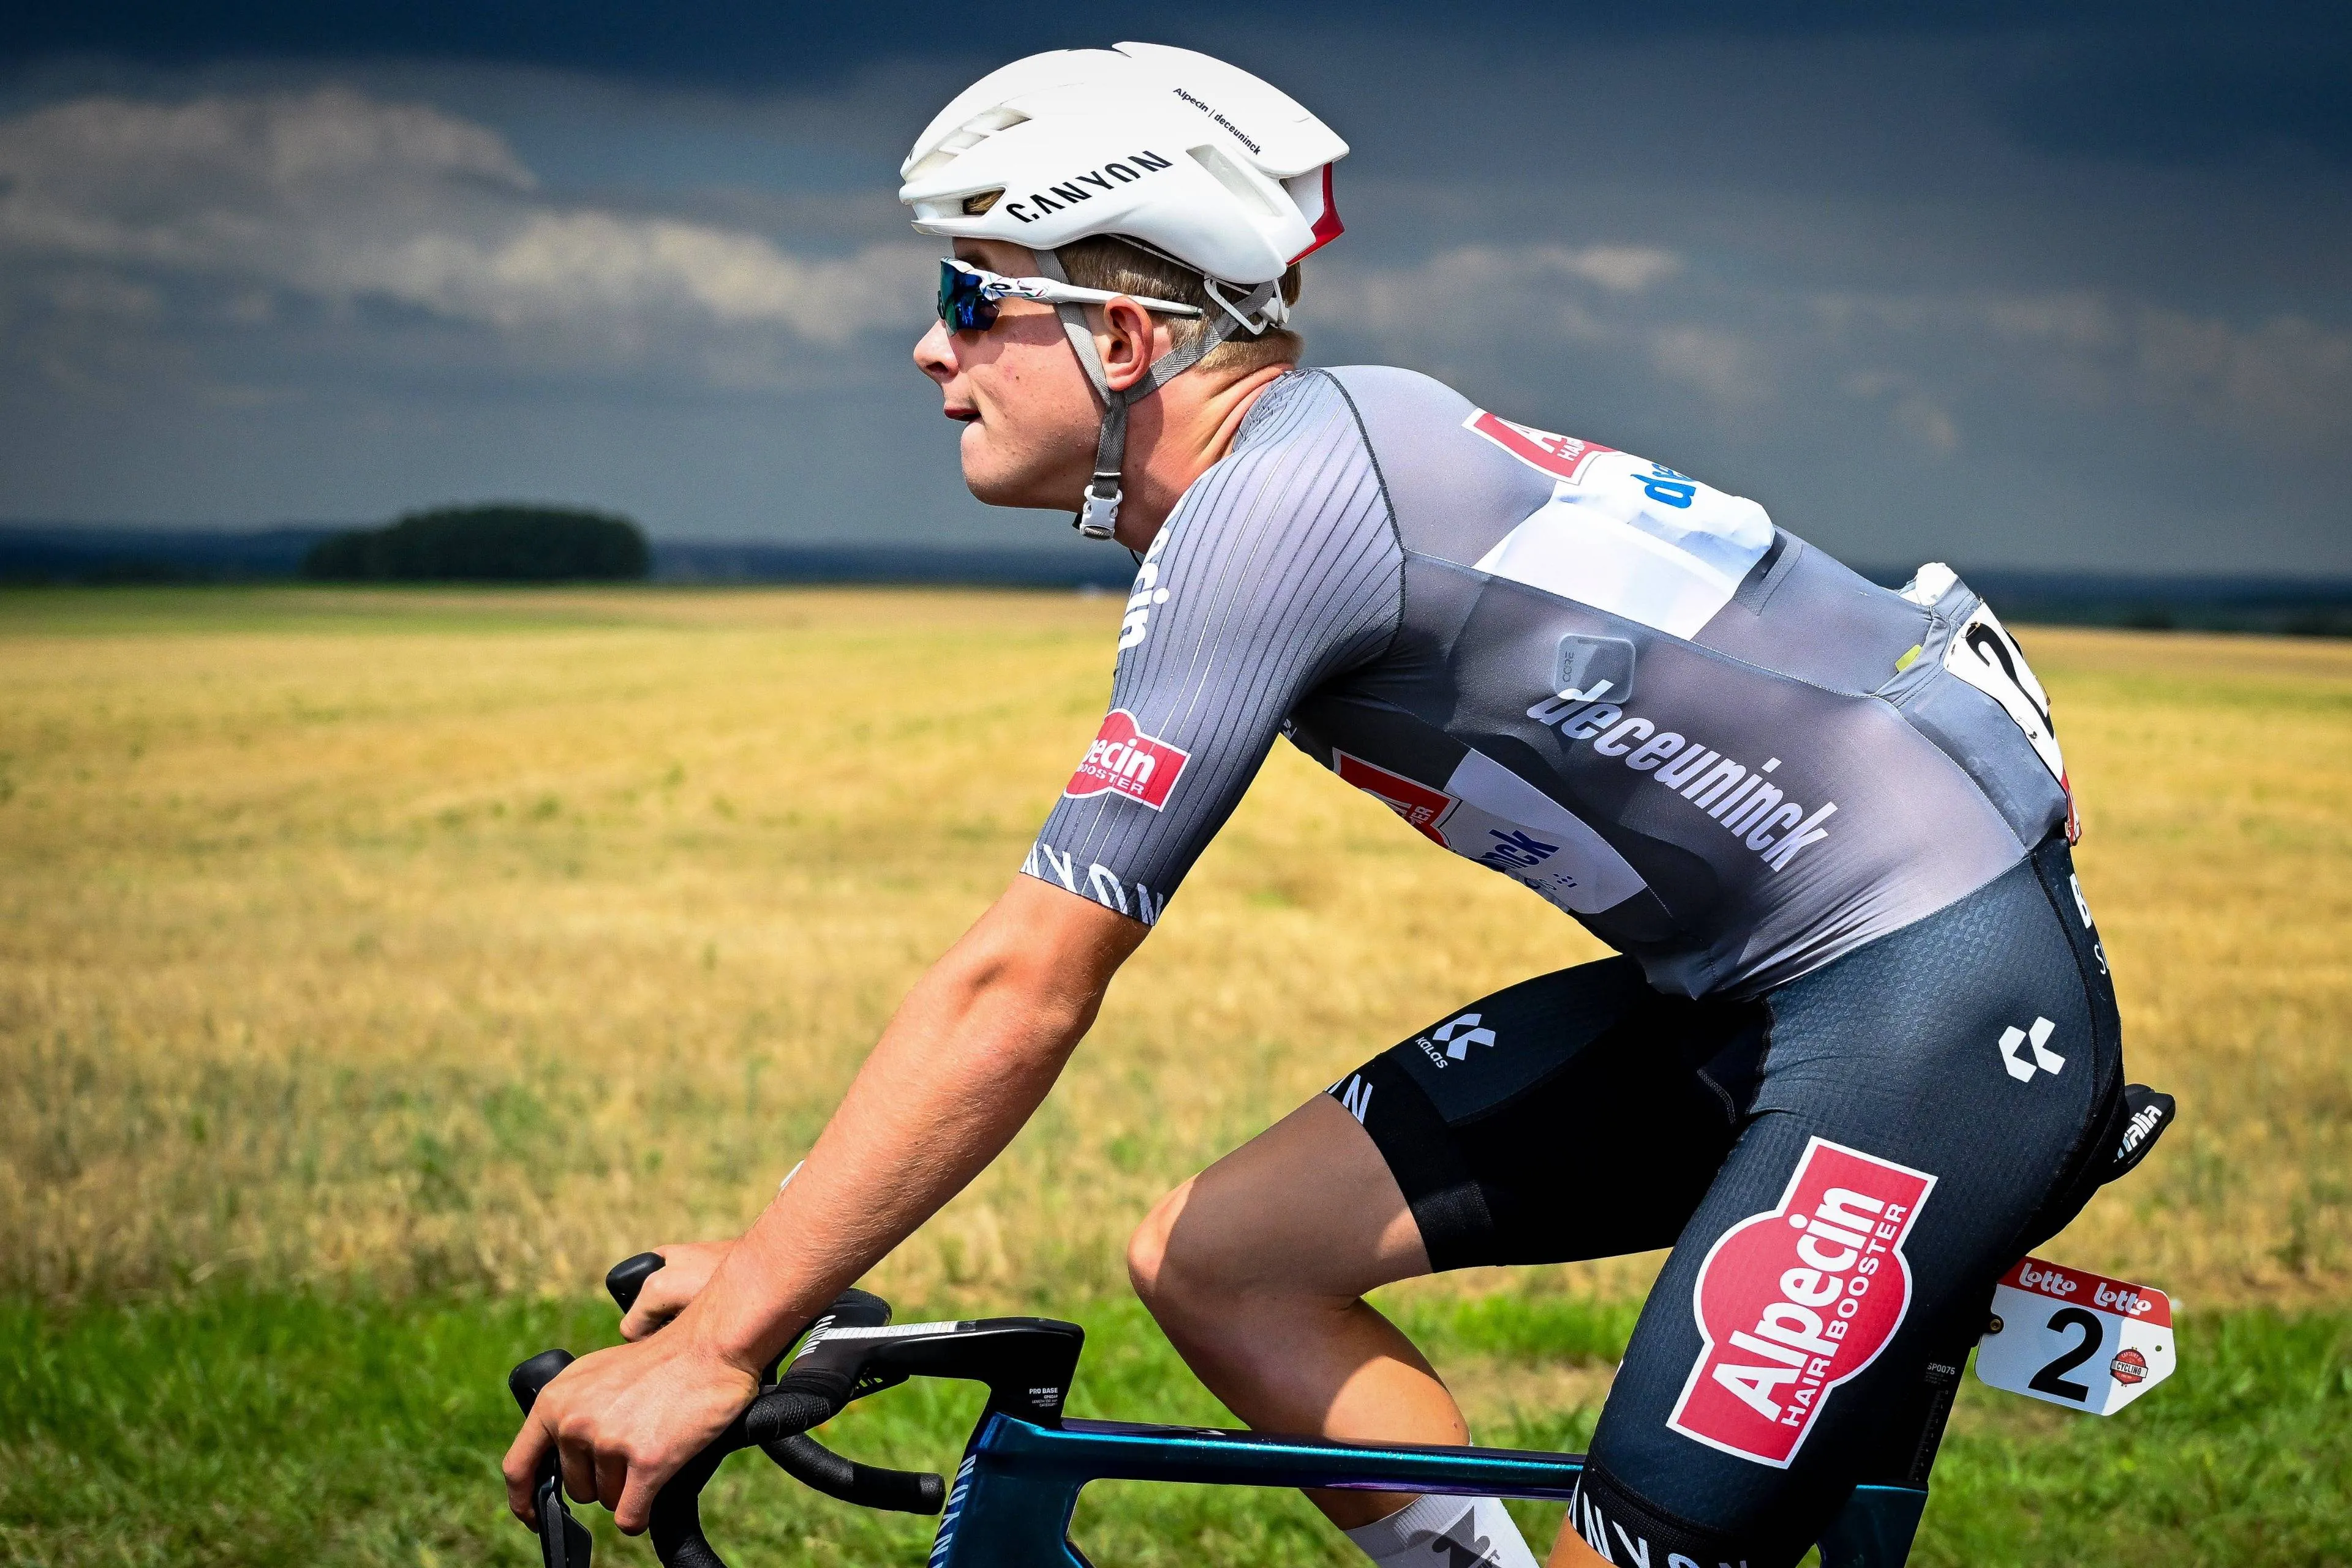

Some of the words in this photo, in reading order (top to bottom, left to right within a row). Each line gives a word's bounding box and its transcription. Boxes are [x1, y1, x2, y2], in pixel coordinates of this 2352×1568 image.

[1172, 88, 1208, 112] Alpecin
[1214, 114, 1261, 155] deceuninck
[1006, 151, 1174, 223] CANYON
[1562, 650, 1575, 682] CORE
[1527, 679, 1838, 872] deceuninck
[1711, 1186, 1887, 1422] Alpecin
[1781, 1356, 1832, 1427] HAIR
[1825, 1202, 1908, 1341] BOOSTER
[1927, 1362, 1956, 1375] SP0075
[2027, 1307, 2103, 1403] 2
[930, 1454, 977, 1568] NYON
